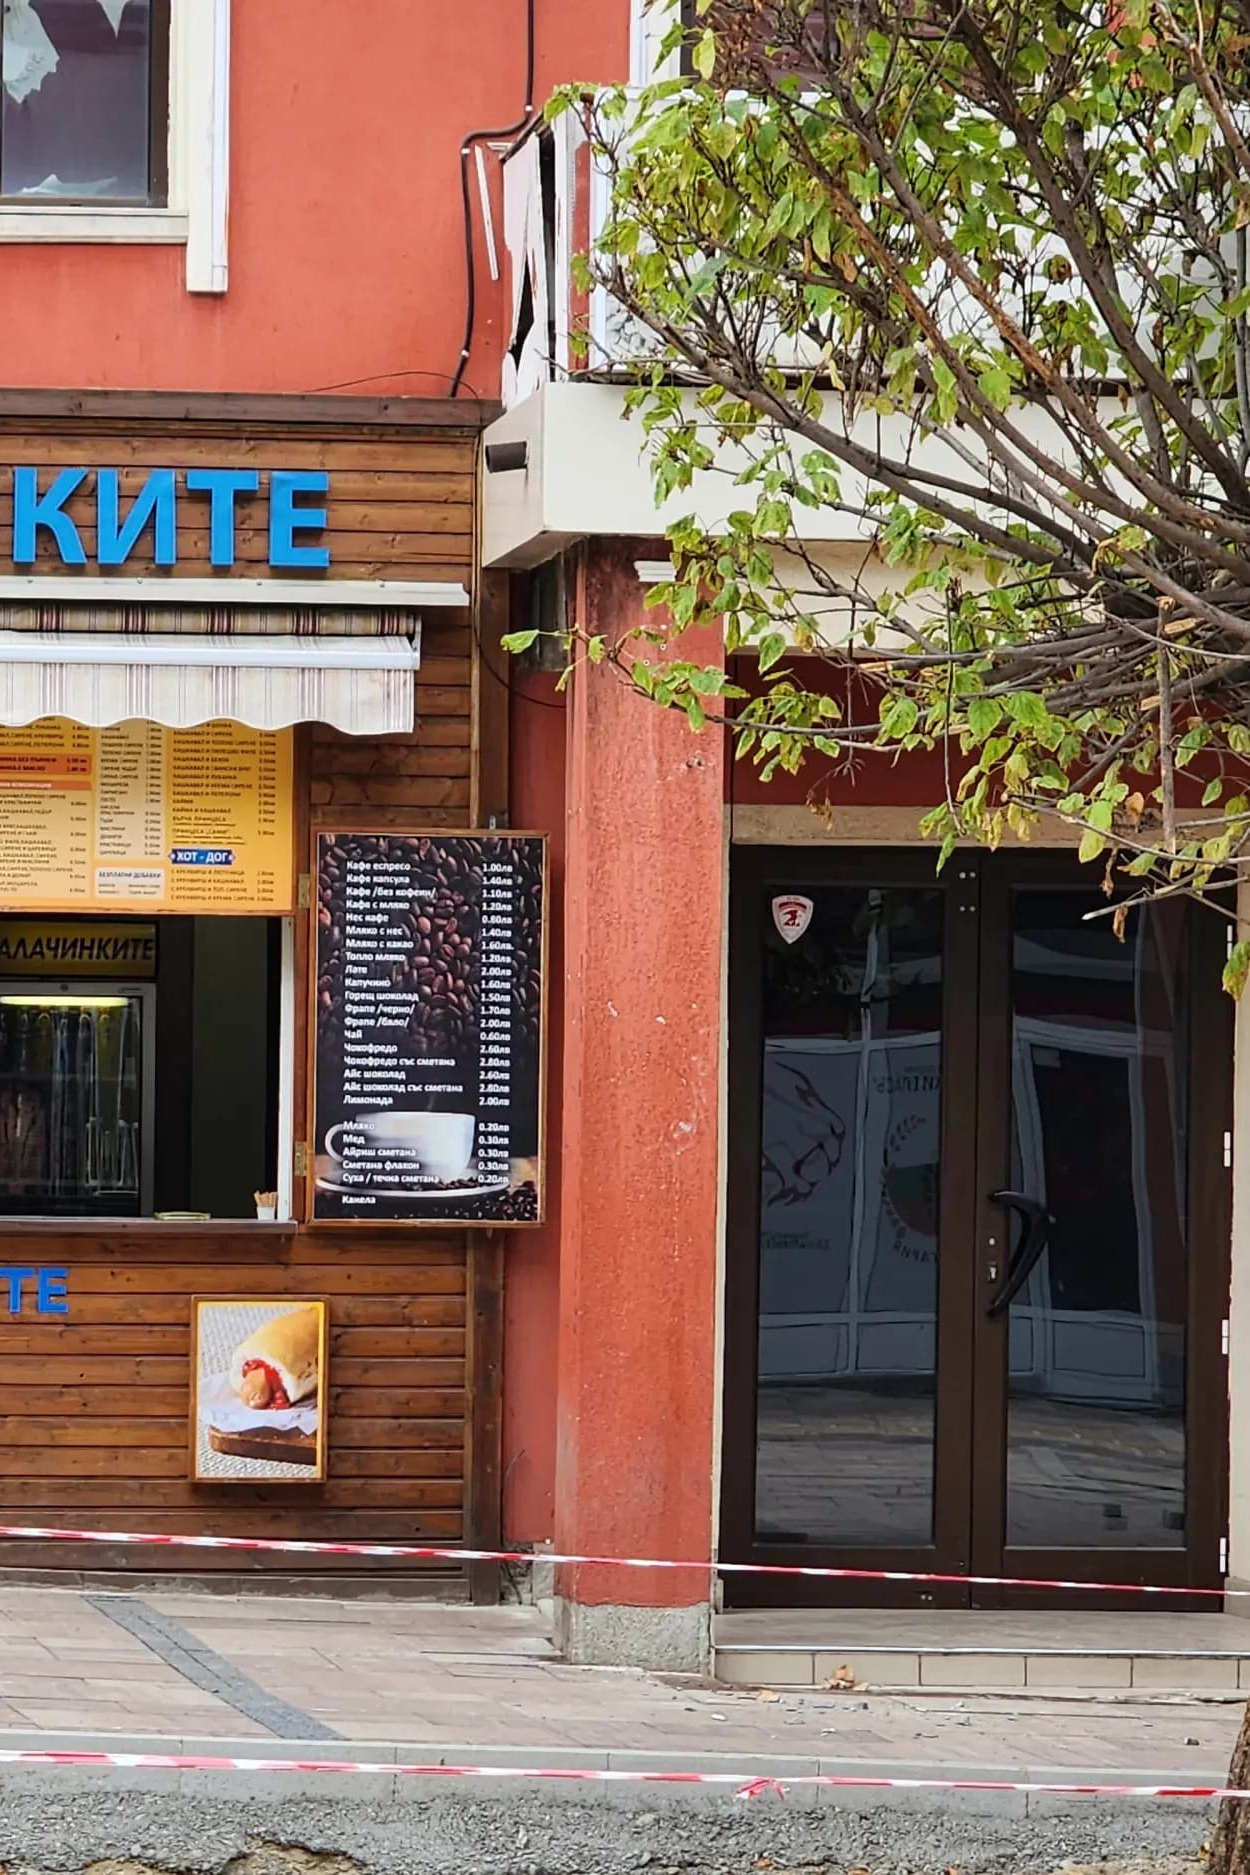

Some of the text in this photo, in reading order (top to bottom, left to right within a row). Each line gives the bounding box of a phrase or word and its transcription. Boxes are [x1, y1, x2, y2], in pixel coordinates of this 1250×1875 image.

[177, 852, 198, 862] ХОТ
[206, 852, 228, 863] ДОГ
[347, 862, 513, 872] Кафе еспресо 1.00лв
[347, 875, 513, 885] Кафе капсула 1.40лв
[346, 888, 371, 897] Кафе
[372, 887, 394, 897] /без
[482, 890, 512, 898] 1.10лв
[346, 900, 370, 909] Кафе
[482, 903, 512, 911] 1.20лв
[346, 914, 363, 922] Нес
[365, 913, 389, 923] кафе
[346, 926, 378, 935] Мляко
[481, 929, 512, 937] 1.40лв
[346, 939, 377, 948] Мляко
[346, 952, 373, 961] Топло
[345, 965, 511, 976] Лате 2.00лв
[345, 978, 390, 987] Капучино
[345, 991, 375, 1001] Горещ
[376, 993, 419, 1001] шоколад
[344, 1004, 375, 1013] Фрапе
[344, 1017, 375, 1027] Фрапе
[480, 1020, 511, 1028] 2.00лв
[344, 1030, 362, 1039] Чай
[344, 1043, 398, 1053] Чокофредо
[344, 1056, 397, 1066] Чокофредо
[344, 1069, 362, 1078] Айс
[364, 1071, 406, 1080] шоколад
[343, 1082, 362, 1091] Айс
[363, 1084, 406, 1093] шоколад
[407, 1084, 423, 1092] със
[343, 1095, 510, 1106] Лимонада 2.00лв
[343, 1121, 375, 1130] Мляко
[343, 1134, 365, 1144] Мед
[343, 1147, 375, 1157] Айриш
[377, 1149, 416, 1157] сметана
[342, 1160, 383, 1169] Сметана
[384, 1160, 419, 1170] флакон
[342, 1173, 364, 1183] Суха
[342, 1195, 376, 1204] Канела
